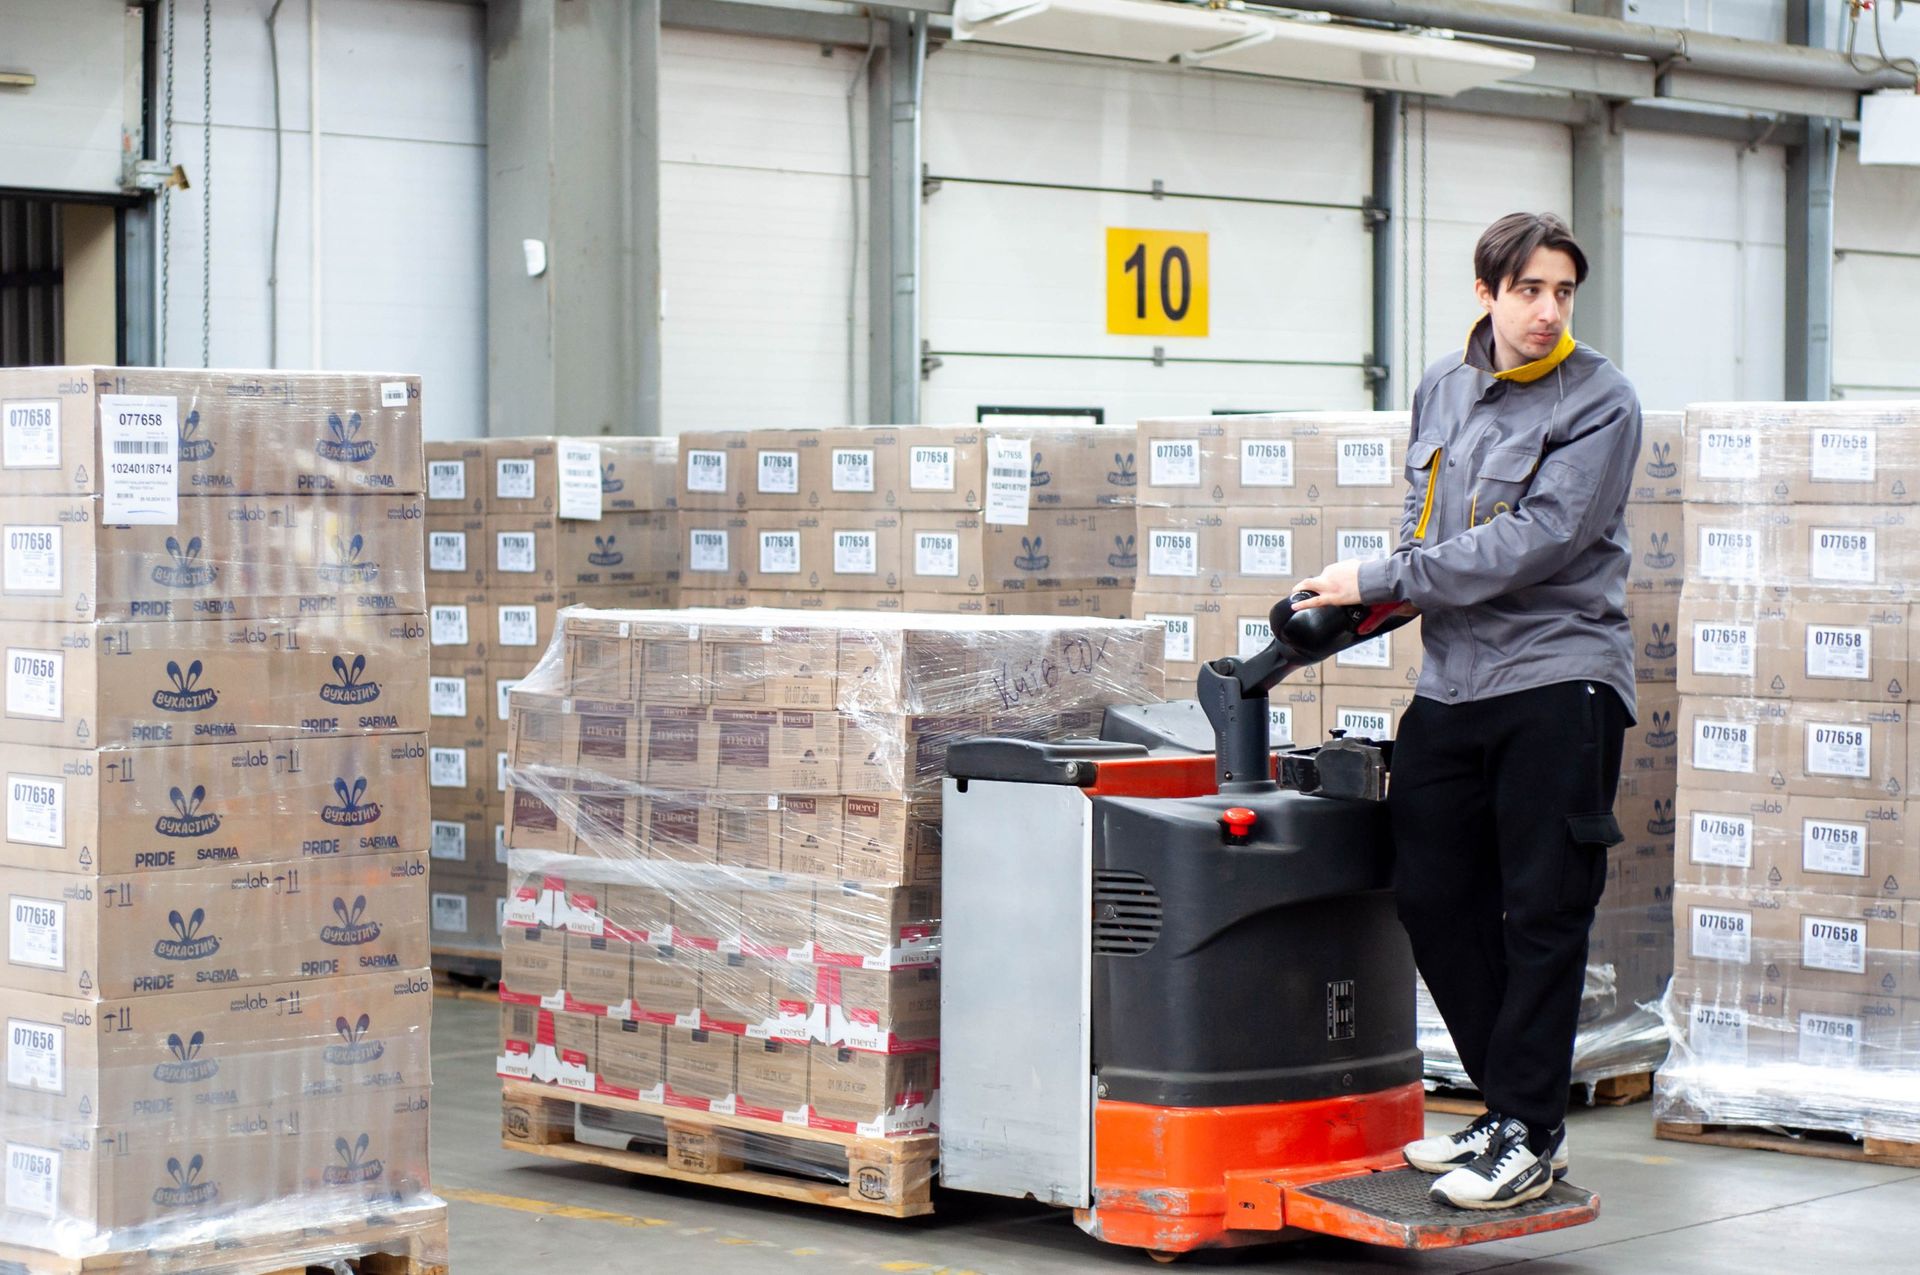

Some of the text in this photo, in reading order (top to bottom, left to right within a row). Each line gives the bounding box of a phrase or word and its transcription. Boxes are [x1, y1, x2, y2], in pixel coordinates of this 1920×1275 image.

[1124, 243, 1191, 321] 10
[10, 408, 51, 427] 077658
[119, 413, 163, 426] 077658
[1708, 434, 1752, 448] 077658
[1821, 434, 1868, 449] 077658
[916, 450, 949, 463] 077658
[1157, 444, 1192, 458] 077658
[1248, 444, 1286, 458] 077658
[1344, 443, 1384, 457] 077658
[693, 454, 721, 467] 077658
[763, 455, 792, 467] 077658
[837, 453, 868, 466] 077658
[111, 463, 172, 475] 102401/8714
[192, 475, 233, 488] SARMA
[298, 475, 395, 489] PRIDE SARMA
[11, 532, 52, 550] 077658
[695, 534, 723, 546] 077658
[765, 535, 794, 547] 077658
[839, 535, 869, 548] 077658
[921, 537, 952, 549] 077658
[1155, 535, 1191, 549] 077658
[1247, 534, 1285, 548] 077658
[1344, 535, 1383, 549] 077658
[1708, 533, 1752, 548] 077658
[1820, 534, 1867, 550] 077658
[131, 600, 236, 616] PRIDE SARMA
[299, 596, 396, 611] PRIDE SARMA
[1245, 623, 1275, 637] 0776
[1702, 629, 1747, 644] 077658
[1815, 631, 1862, 647] 077658
[14, 656, 55, 678] 077658
[156, 691, 214, 708] ВУХАСТИК
[323, 684, 376, 702] ВУХАСТИК
[301, 715, 397, 733] PRIDE SARMA
[783, 714, 811, 723] merci
[1345, 714, 1384, 730] 077658
[132, 723, 237, 740] PRIDE SARMA
[1702, 725, 1747, 742] 077658
[1816, 729, 1862, 746] 077658
[726, 733, 764, 746] merci
[14, 783, 55, 806] 077658
[786, 799, 814, 809] merci
[849, 802, 877, 812] merci
[324, 804, 378, 823] ВУХАСТИК
[159, 816, 216, 834] ВУХАСТИК
[1700, 820, 1745, 837] 077658
[1812, 826, 1858, 845] 077658
[303, 835, 399, 855] PRIDE SARMA
[135, 847, 239, 868] PRIDE SARMA
[16, 904, 55, 927] 077658
[512, 911, 535, 921] merci
[1700, 914, 1744, 931] 077658
[323, 924, 377, 942] ВУХАСТИК
[571, 921, 595, 932] merci
[1812, 923, 1858, 943] 077658
[158, 938, 215, 957] ВУХАСТИК
[301, 954, 398, 976] PRIDE SARMA
[133, 969, 239, 992] PRIDE SARMA
[1807, 1018, 1854, 1037] 077658
[14, 1027, 54, 1050] 077658
[850, 1037, 877, 1049] merci
[505, 1064, 528, 1075] merci
[562, 1076, 586, 1087] merci
[895, 1117, 924, 1128] merci
[12, 1151, 51, 1175] 077658
